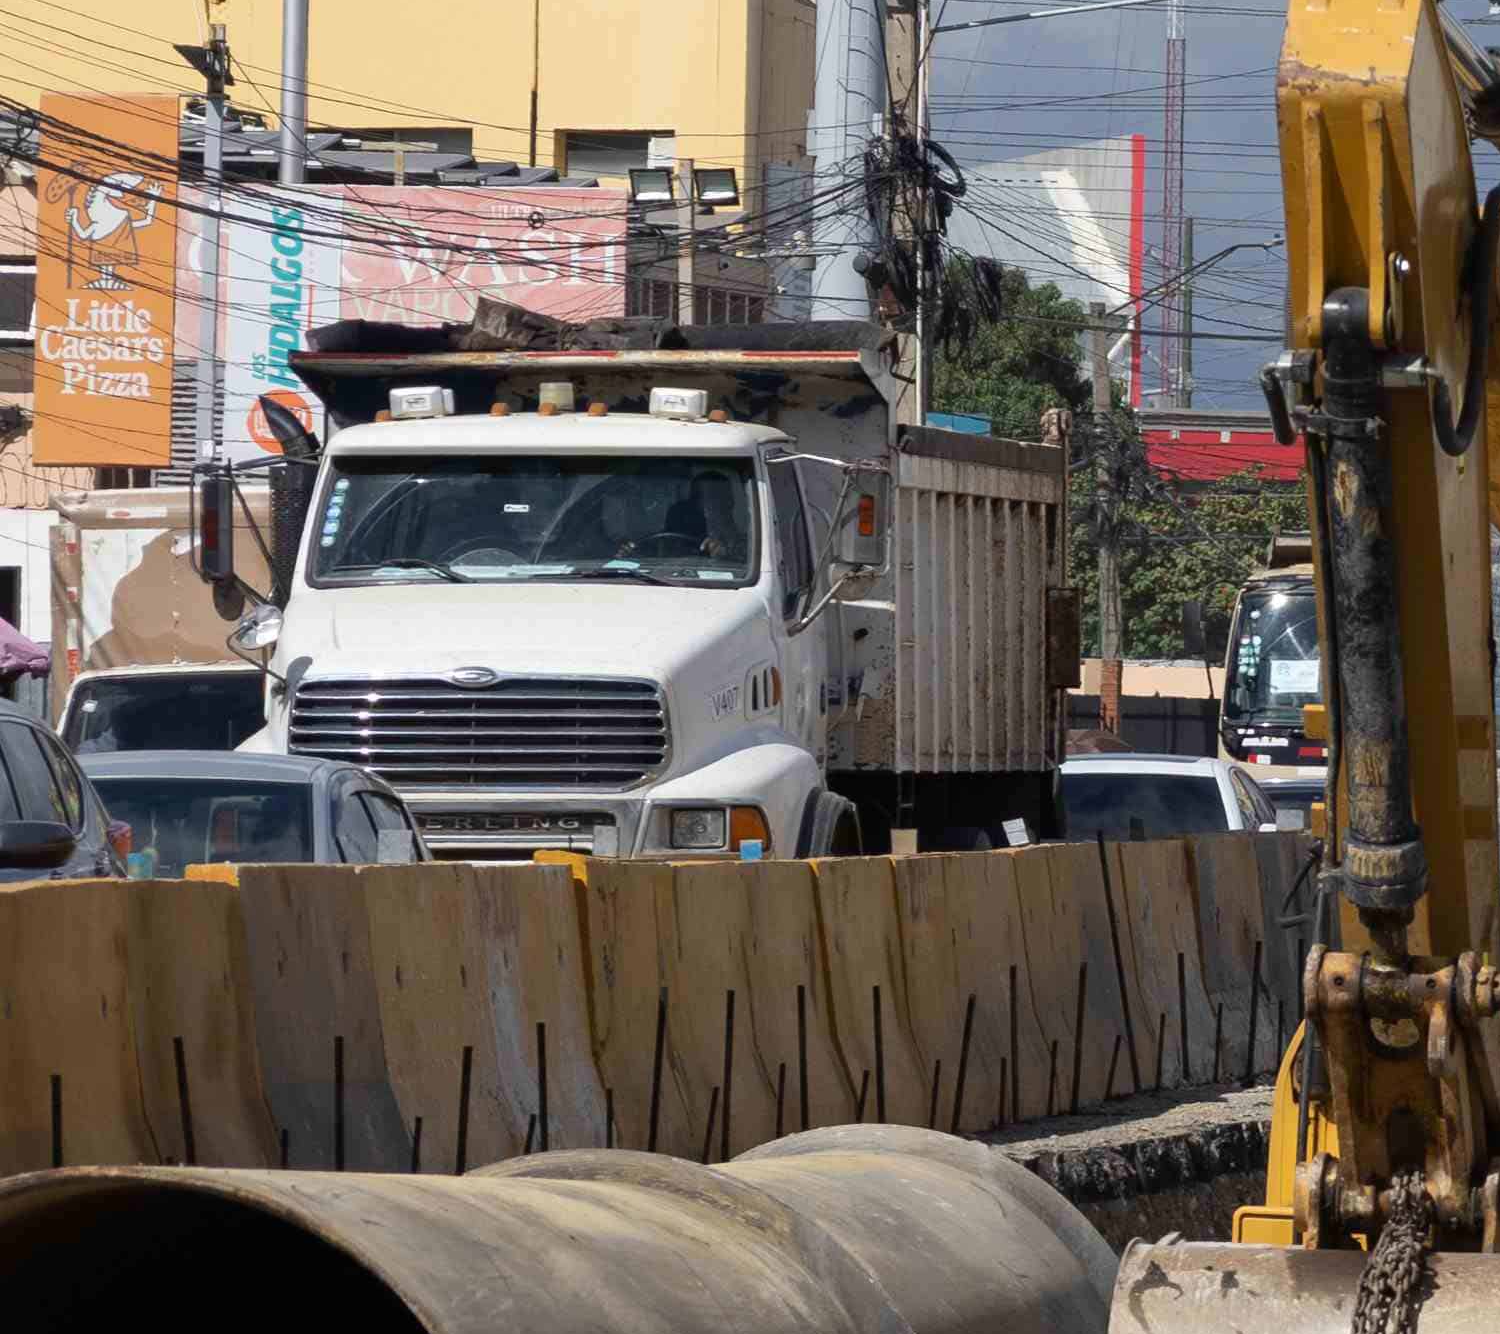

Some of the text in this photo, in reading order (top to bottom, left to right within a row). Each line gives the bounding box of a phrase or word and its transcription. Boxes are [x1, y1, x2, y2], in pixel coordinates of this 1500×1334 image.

[64, 298, 152, 333] Little
[39, 326, 166, 361] Caesars
[60, 362, 151, 398] Pizza
[425, 816, 579, 830] ERLING
